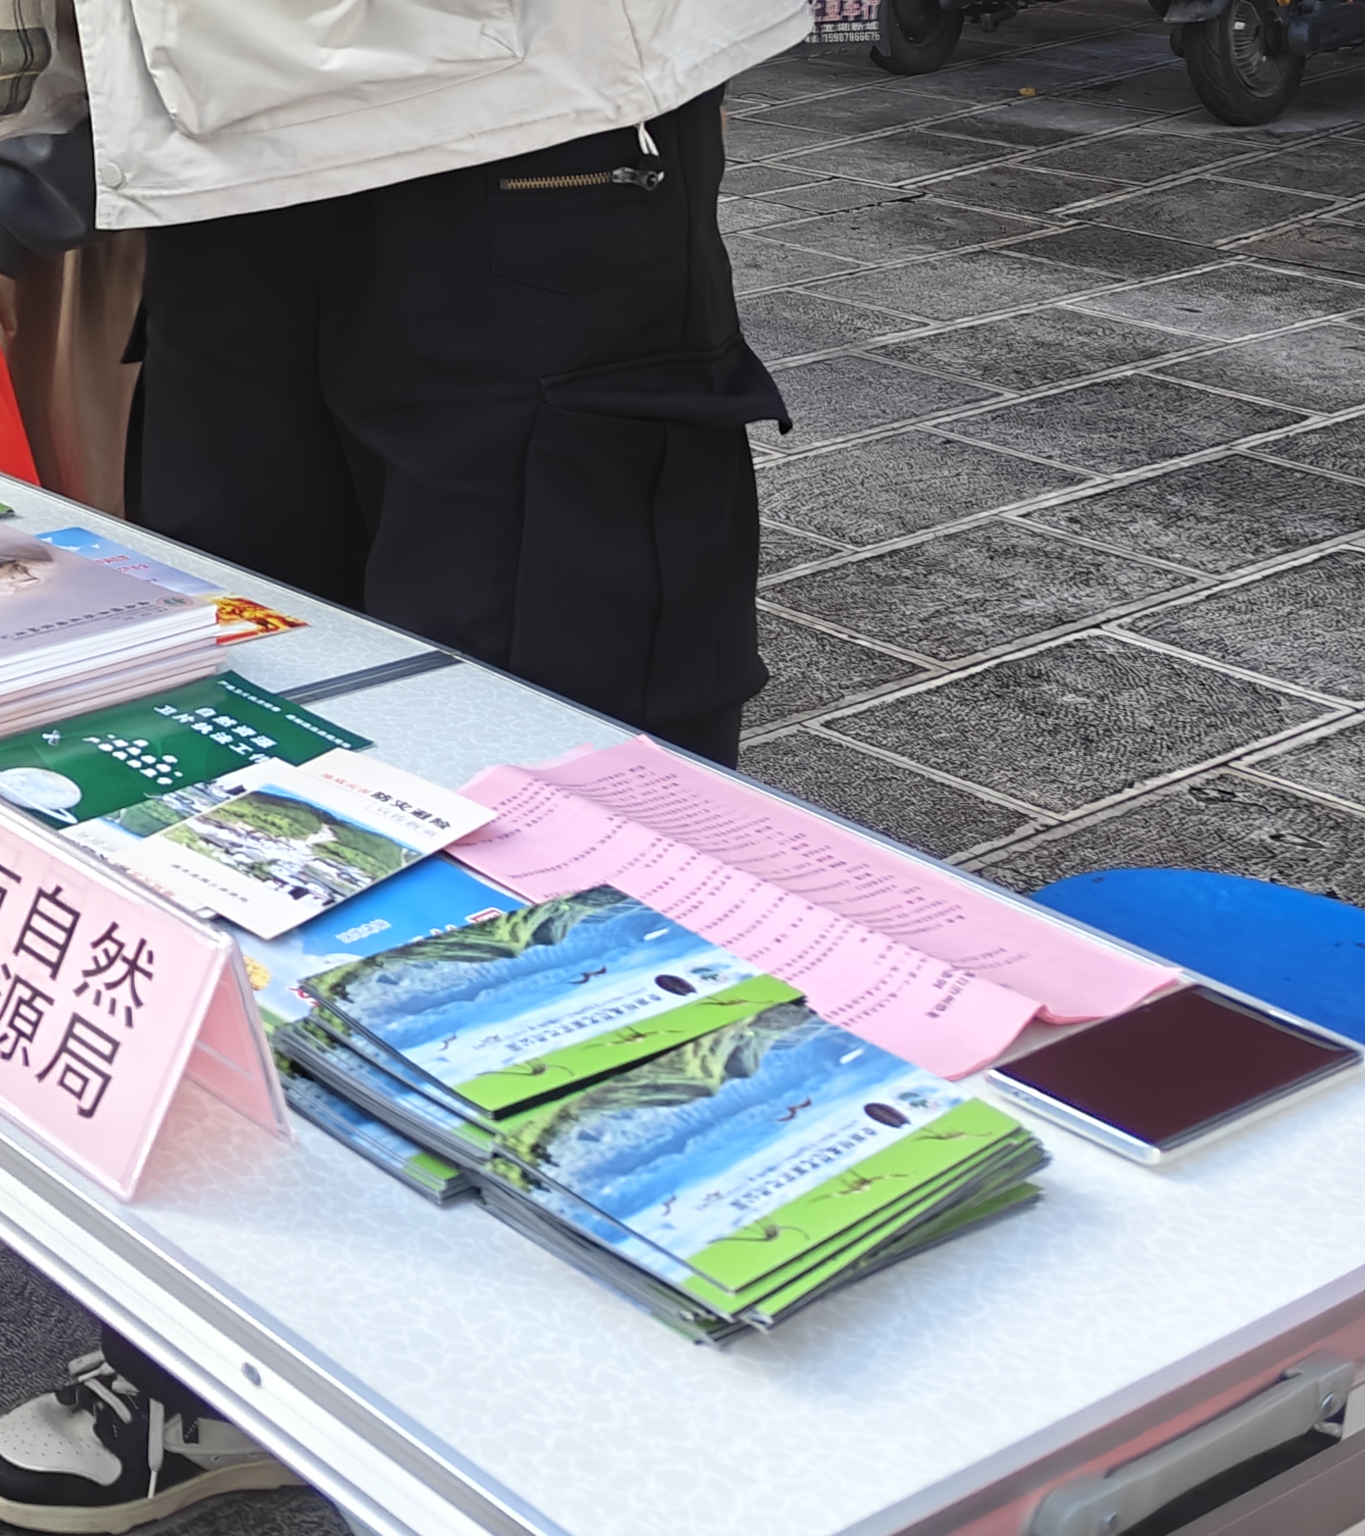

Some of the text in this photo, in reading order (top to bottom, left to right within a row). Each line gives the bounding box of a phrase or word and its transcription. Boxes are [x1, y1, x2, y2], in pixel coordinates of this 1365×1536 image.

[194, 706, 278, 750] 自然资源
[370, 791, 451, 830] 防灾避险
